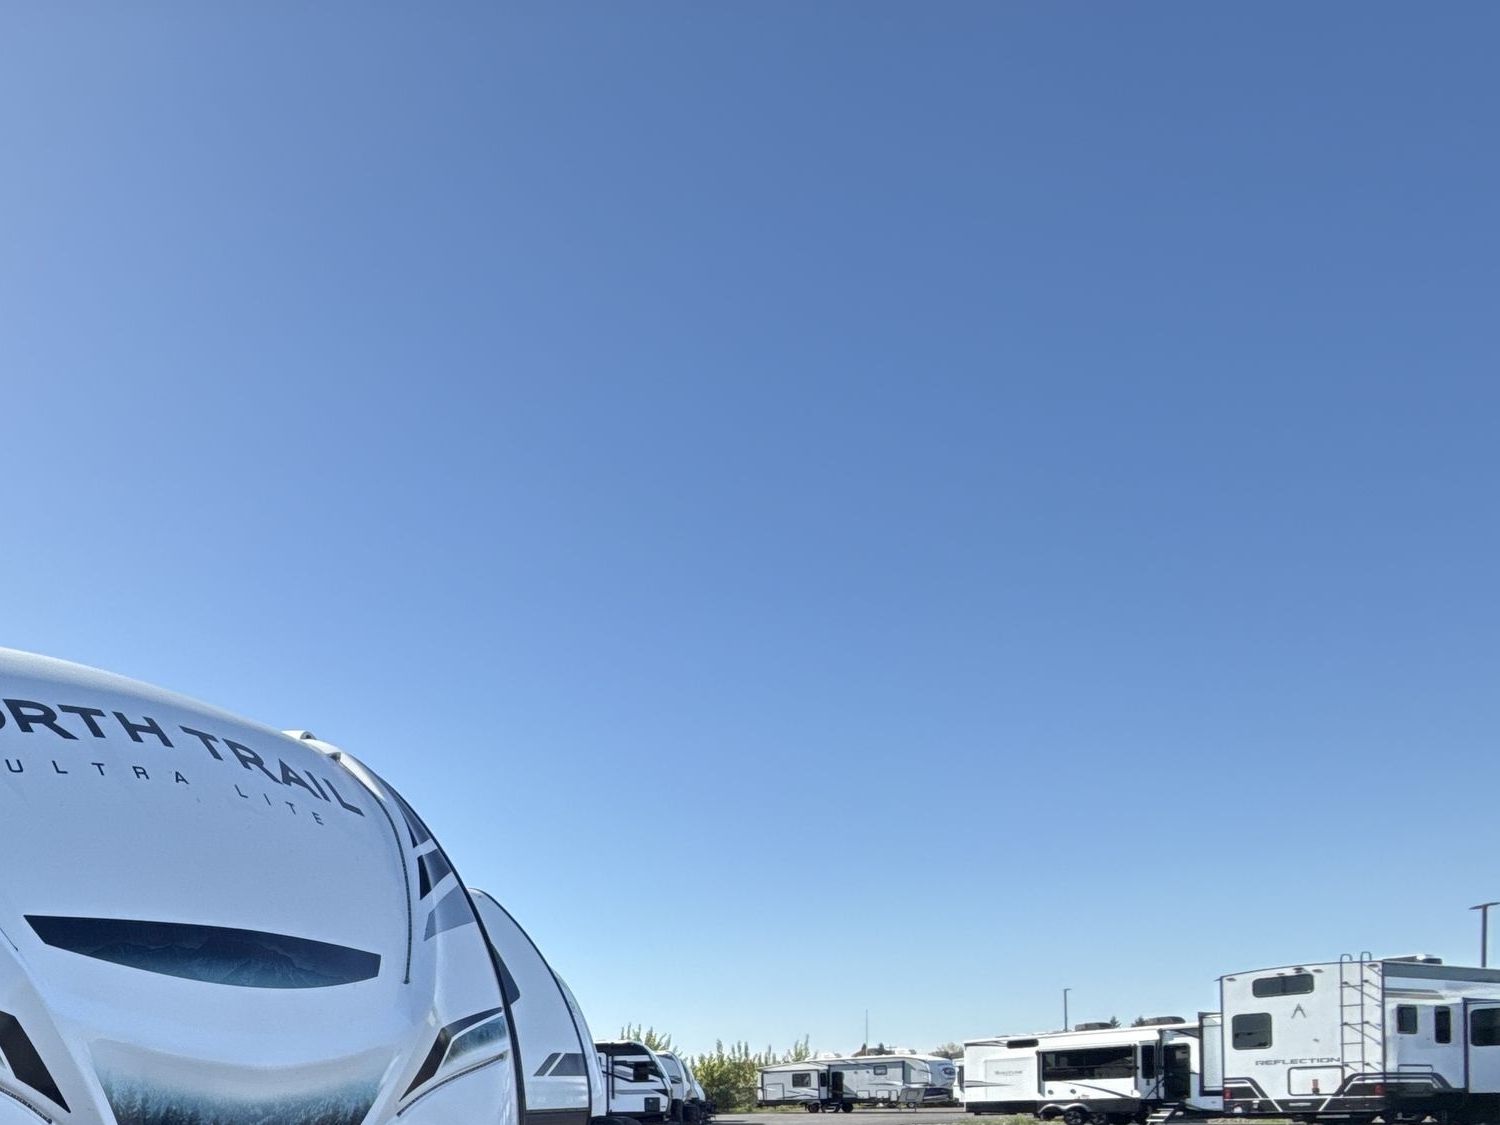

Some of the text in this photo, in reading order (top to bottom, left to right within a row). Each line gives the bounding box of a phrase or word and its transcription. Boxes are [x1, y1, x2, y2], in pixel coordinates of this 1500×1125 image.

[5, 758, 325, 827] ULTRA LITE
[179, 726, 365, 817] TRAIL
[1255, 1056, 1341, 1066] REFLECTION
